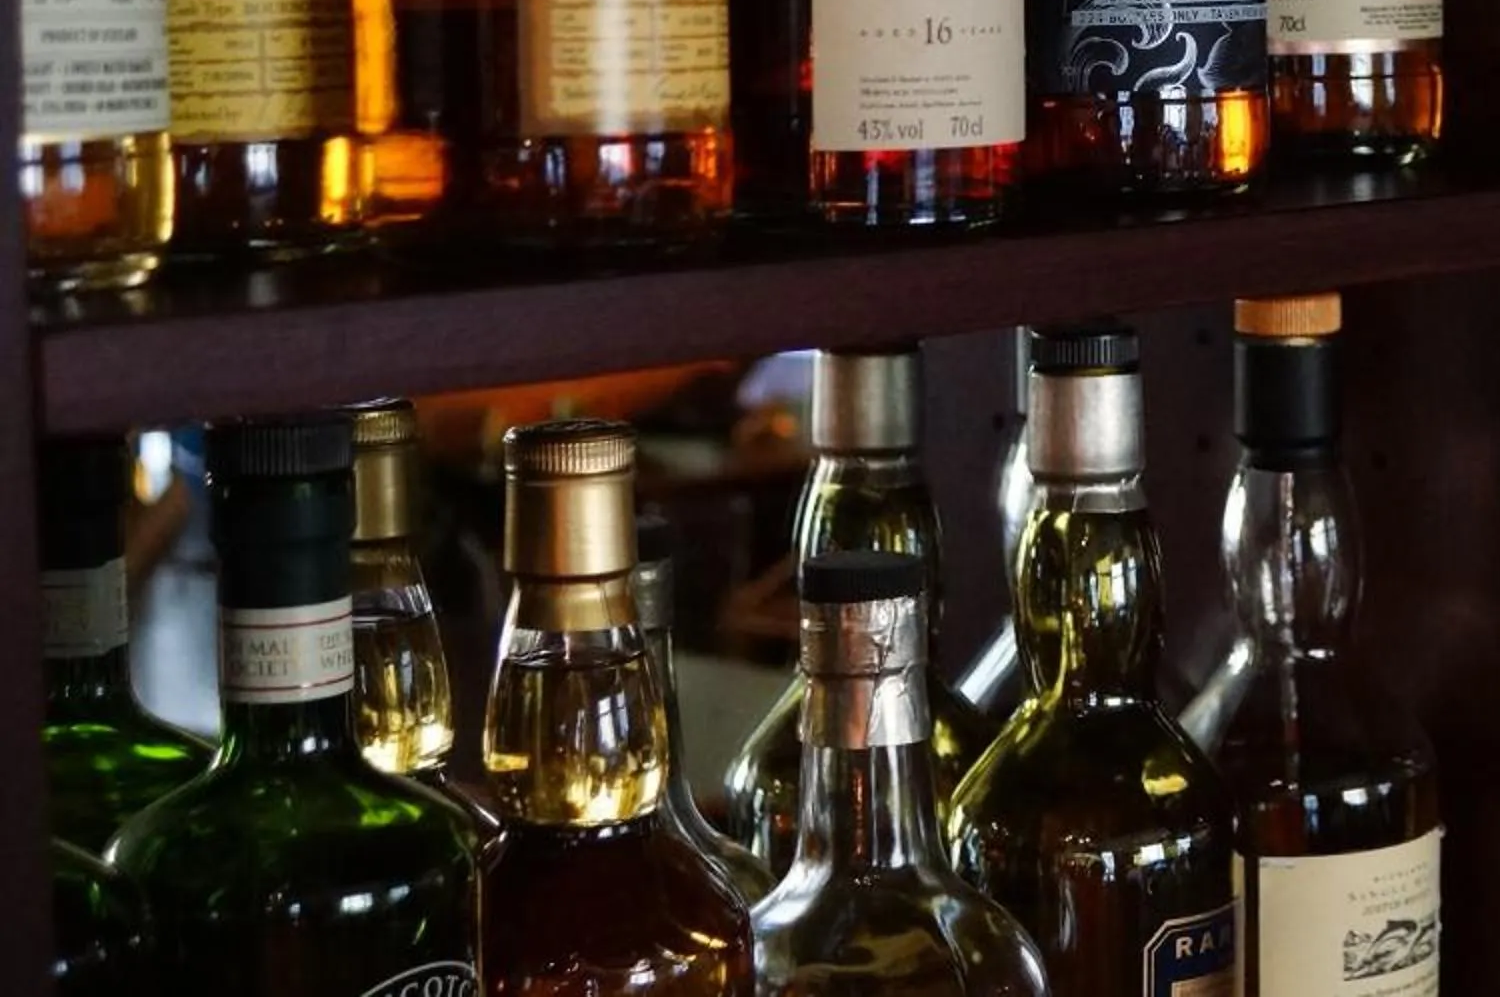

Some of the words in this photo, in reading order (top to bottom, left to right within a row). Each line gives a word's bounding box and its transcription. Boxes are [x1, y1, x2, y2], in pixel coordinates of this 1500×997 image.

[925, 17, 953, 44] 16
[1279, 16, 1307, 32] 70cl
[897, 119, 924, 140] vol
[951, 116, 984, 137] 70cl
